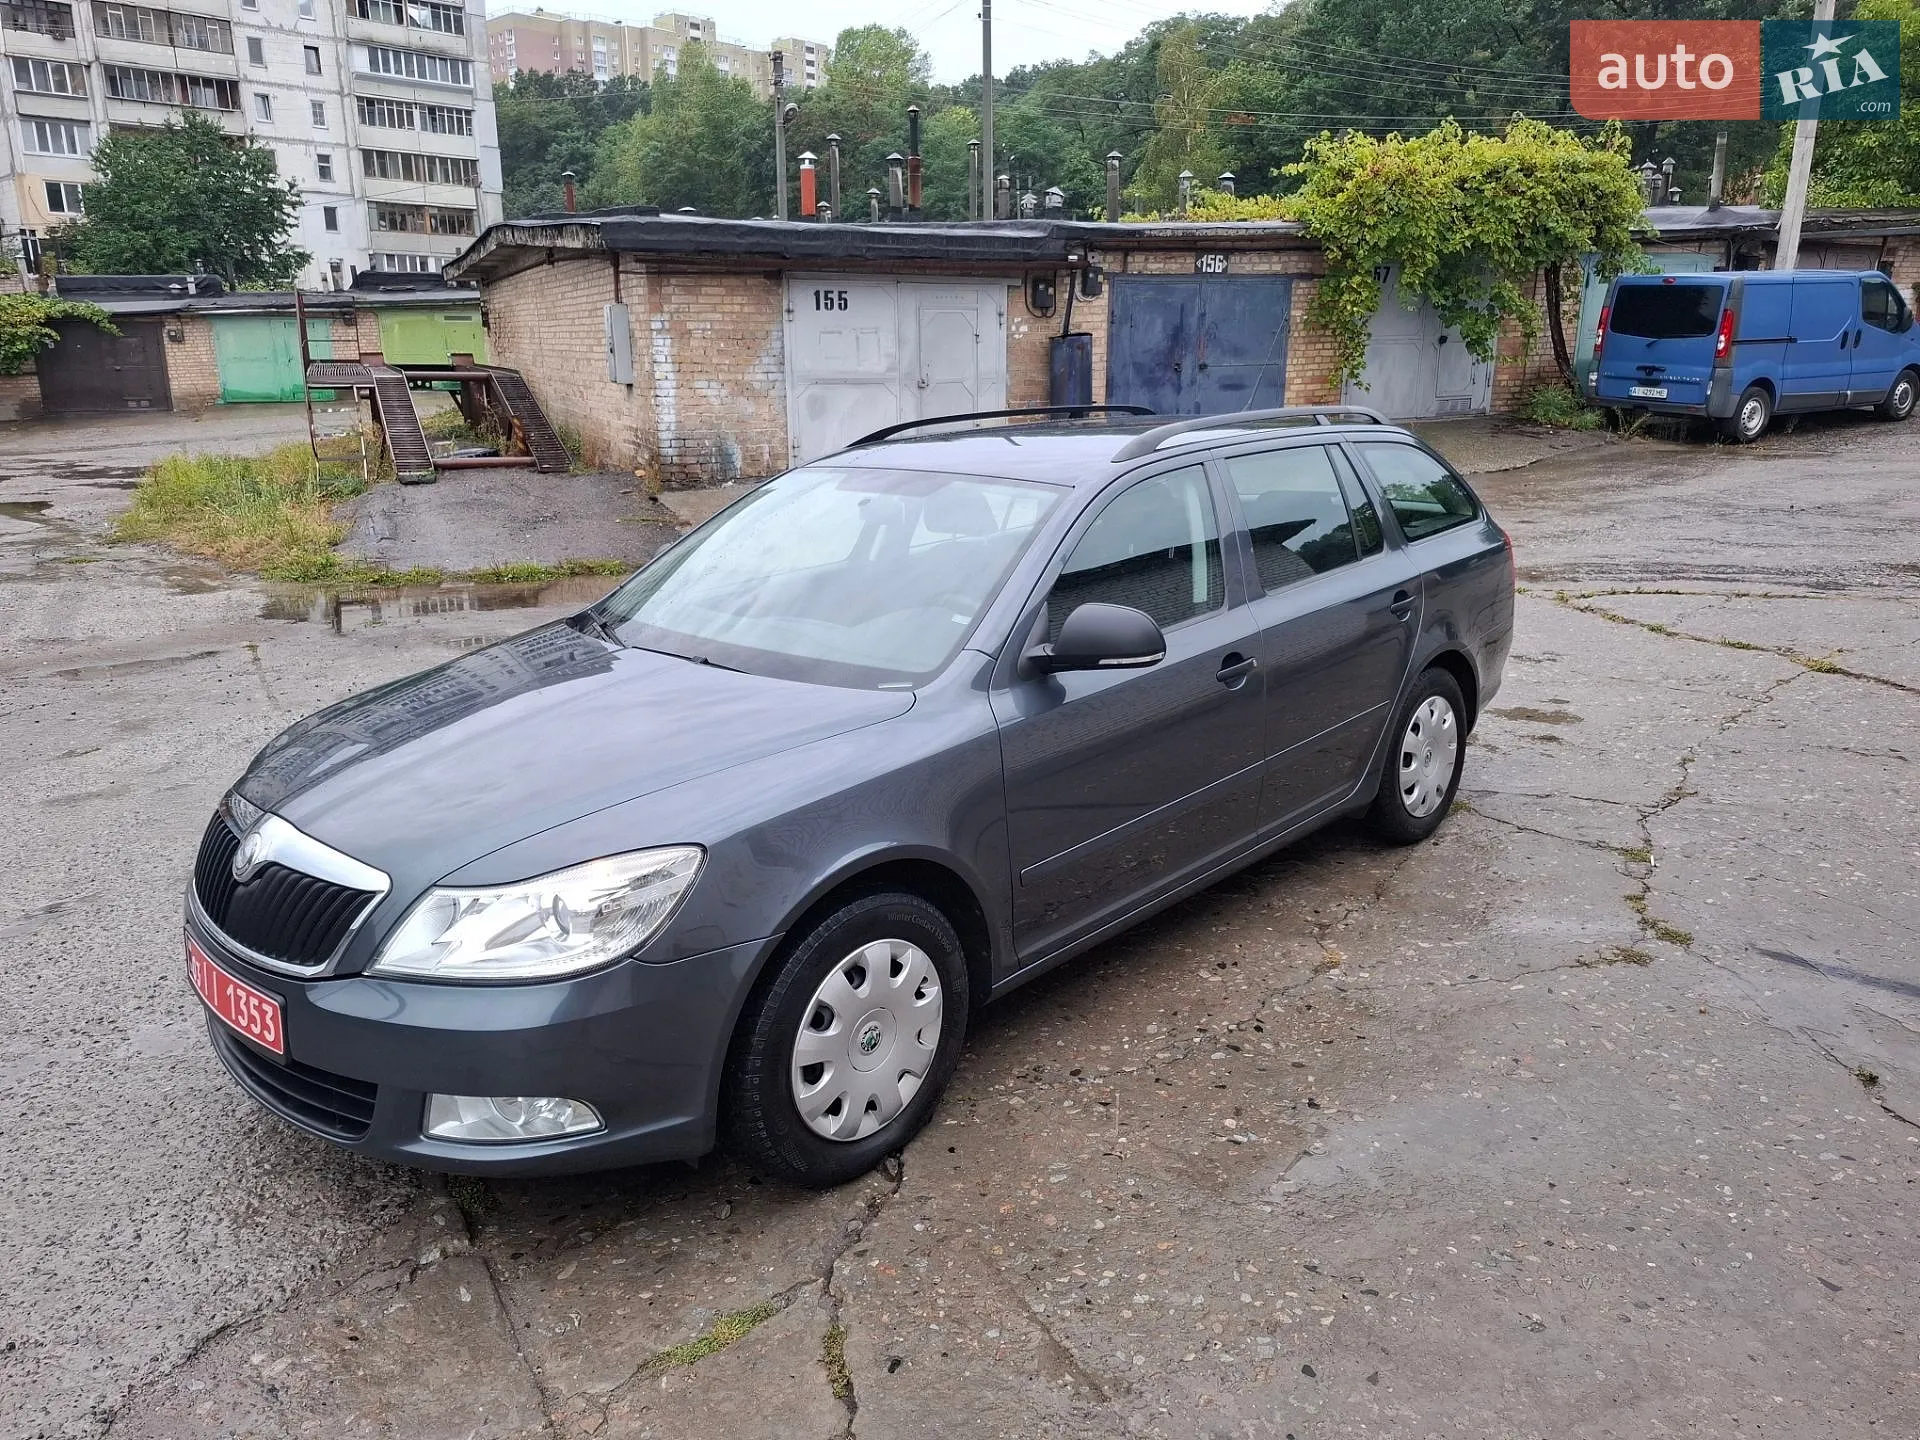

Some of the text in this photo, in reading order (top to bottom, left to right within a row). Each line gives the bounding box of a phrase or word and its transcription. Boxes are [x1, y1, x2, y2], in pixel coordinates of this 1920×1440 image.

[1202, 253, 1225, 273] 156
[813, 289, 849, 312] 155
[226, 983, 277, 1043] 1353
